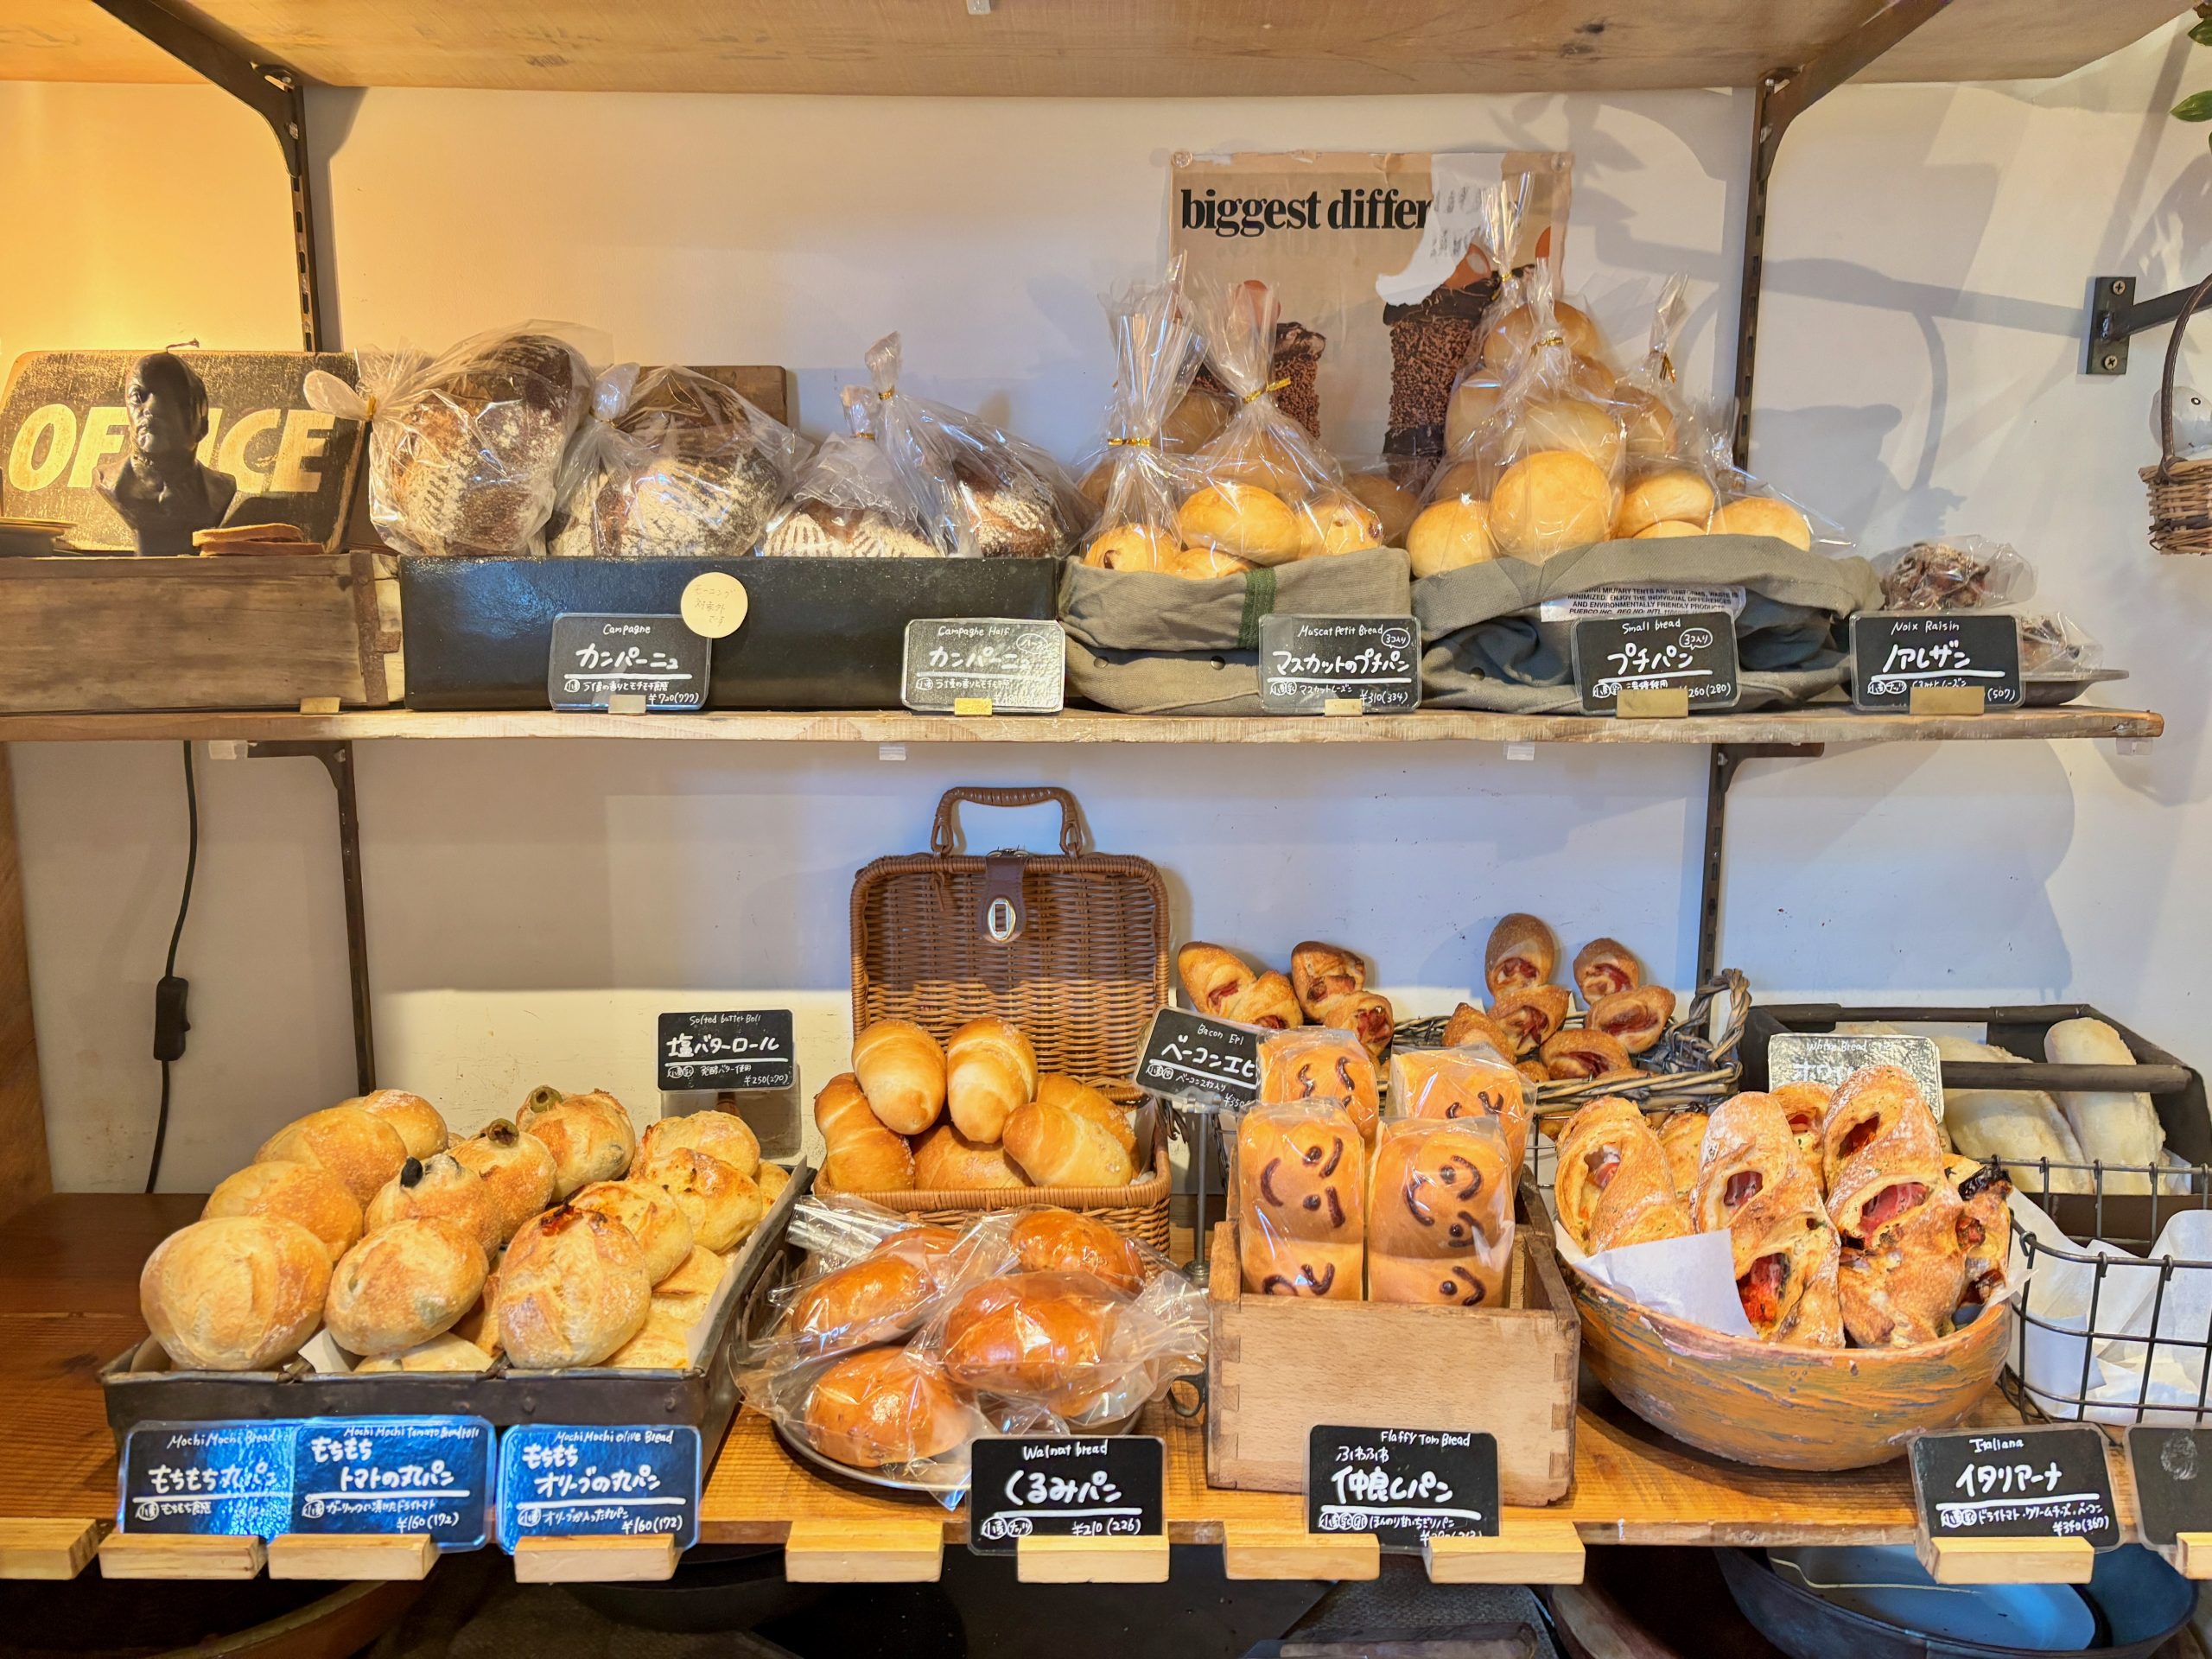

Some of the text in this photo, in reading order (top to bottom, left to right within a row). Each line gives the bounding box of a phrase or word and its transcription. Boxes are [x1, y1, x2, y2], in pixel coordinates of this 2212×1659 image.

[1181, 188, 1321, 238] biggest
[1327, 188, 1433, 230] differ
[9, 403, 337, 493] OFCE
[603, 623, 651, 635] Campagne
[938, 626, 1010, 638] Campagne Half
[1298, 624, 1384, 637] Muscat Petit Bread
[1622, 618, 1681, 635] Small bread
[1891, 620, 1960, 636] Noix Raisin
[575, 642, 679, 670] カンパーニュ
[929, 645, 1030, 669] カンパーニュ
[1272, 648, 1409, 676] マスカットのプチパン
[1607, 642, 1693, 676] プチパン
[1882, 639, 1971, 673] ノアレザン
[1360, 689, 1408, 707] ¥310(334)
[1680, 684, 1732, 697] 260(280)
[1197, 1022, 1224, 1039] Bacon
[666, 1033, 780, 1058] 塩バターロール
[1840, 1040, 1866, 1052] Bread
[744, 1074, 789, 1087] ¥250(270)
[167, 1433, 205, 1449] Mochi
[205, 1433, 243, 1447] Mochi
[343, 1427, 373, 1438] Mochi
[375, 1426, 404, 1438] Mochi
[553, 1431, 583, 1445] Mochi
[583, 1430, 614, 1443] Mochi
[645, 1430, 675, 1445] Bread
[1441, 1433, 1471, 1447] Bread
[310, 1435, 373, 1463] もちもち
[1076, 1439, 1109, 1458] bread
[1968, 1437, 2024, 1453] Italiana
[522, 1443, 579, 1470] もちもち
[1335, 1446, 1390, 1464] ふわふわ
[148, 1460, 277, 1494] もちもち丸パン
[340, 1459, 454, 1491] トマトの丸パン
[534, 1464, 661, 1498] オリーブの丸パン
[1331, 1465, 1453, 1504] 仲良しパン
[1955, 1461, 2063, 1497] イタリアーナ
[1004, 1469, 1122, 1506] くるみパン
[621, 1515, 683, 1535] ¥160(172)
